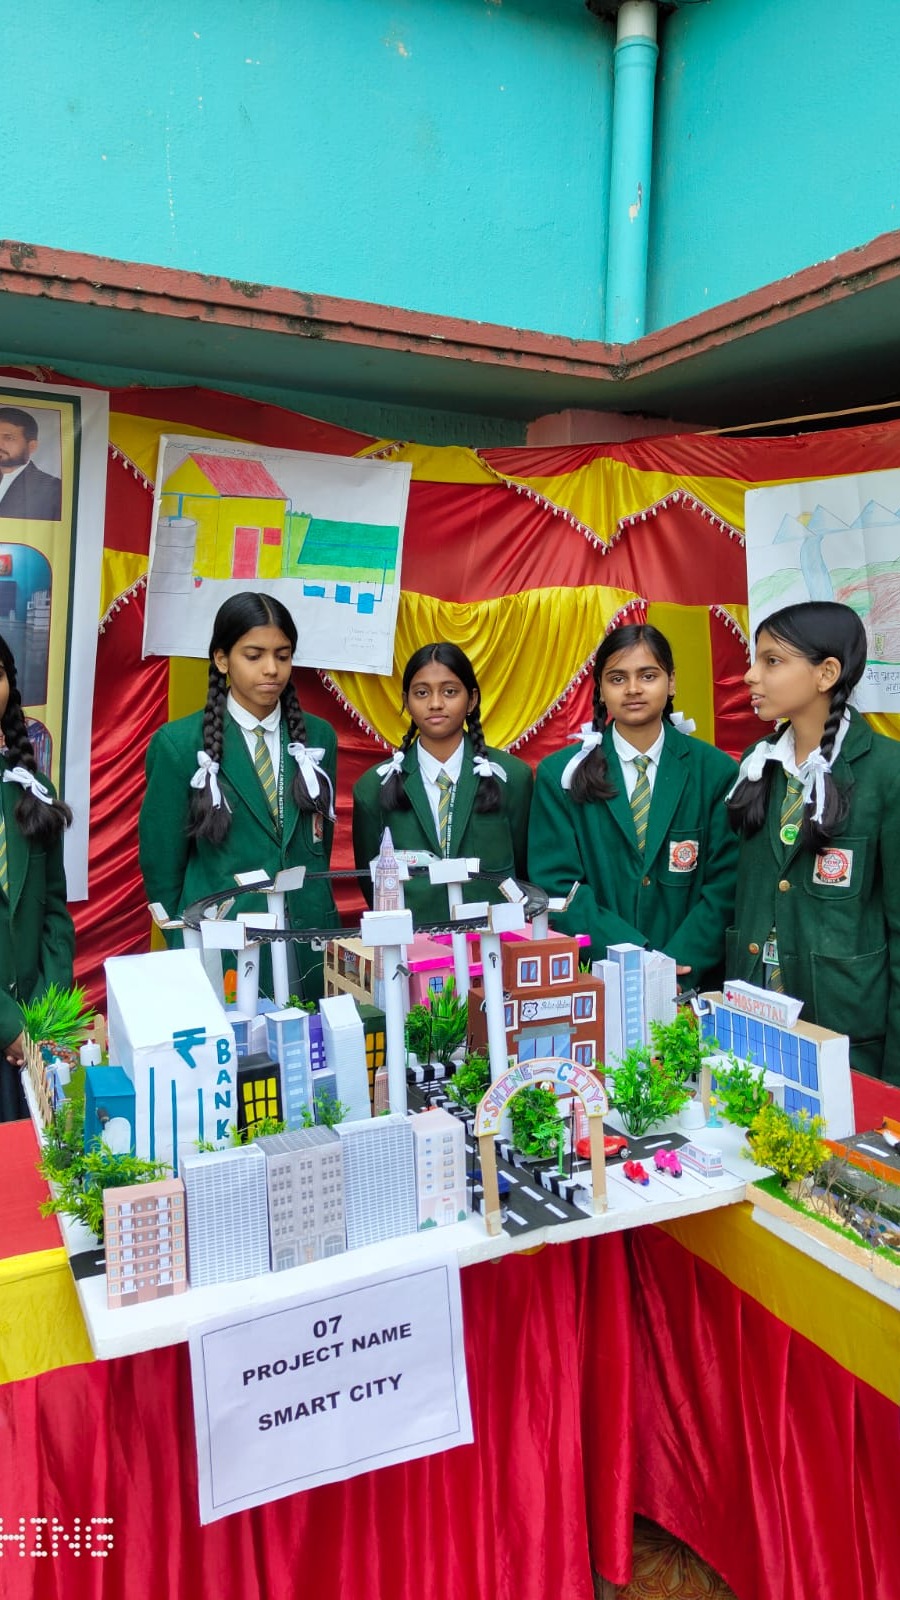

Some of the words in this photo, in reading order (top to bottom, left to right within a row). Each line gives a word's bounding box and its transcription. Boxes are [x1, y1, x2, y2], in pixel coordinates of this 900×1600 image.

[733, 992, 786, 1023] HOSPITAL
[214, 1038, 232, 1141] BANK
[483, 1063, 533, 1118] SHINE
[557, 1062, 604, 1103] CITY
[242, 1342, 344, 1386] PROJECT
[351, 1322, 412, 1353] NAME
[313, 1314, 343, 1339] 07
[258, 1391, 341, 1432] SMART
[349, 1373, 403, 1402] CITY
